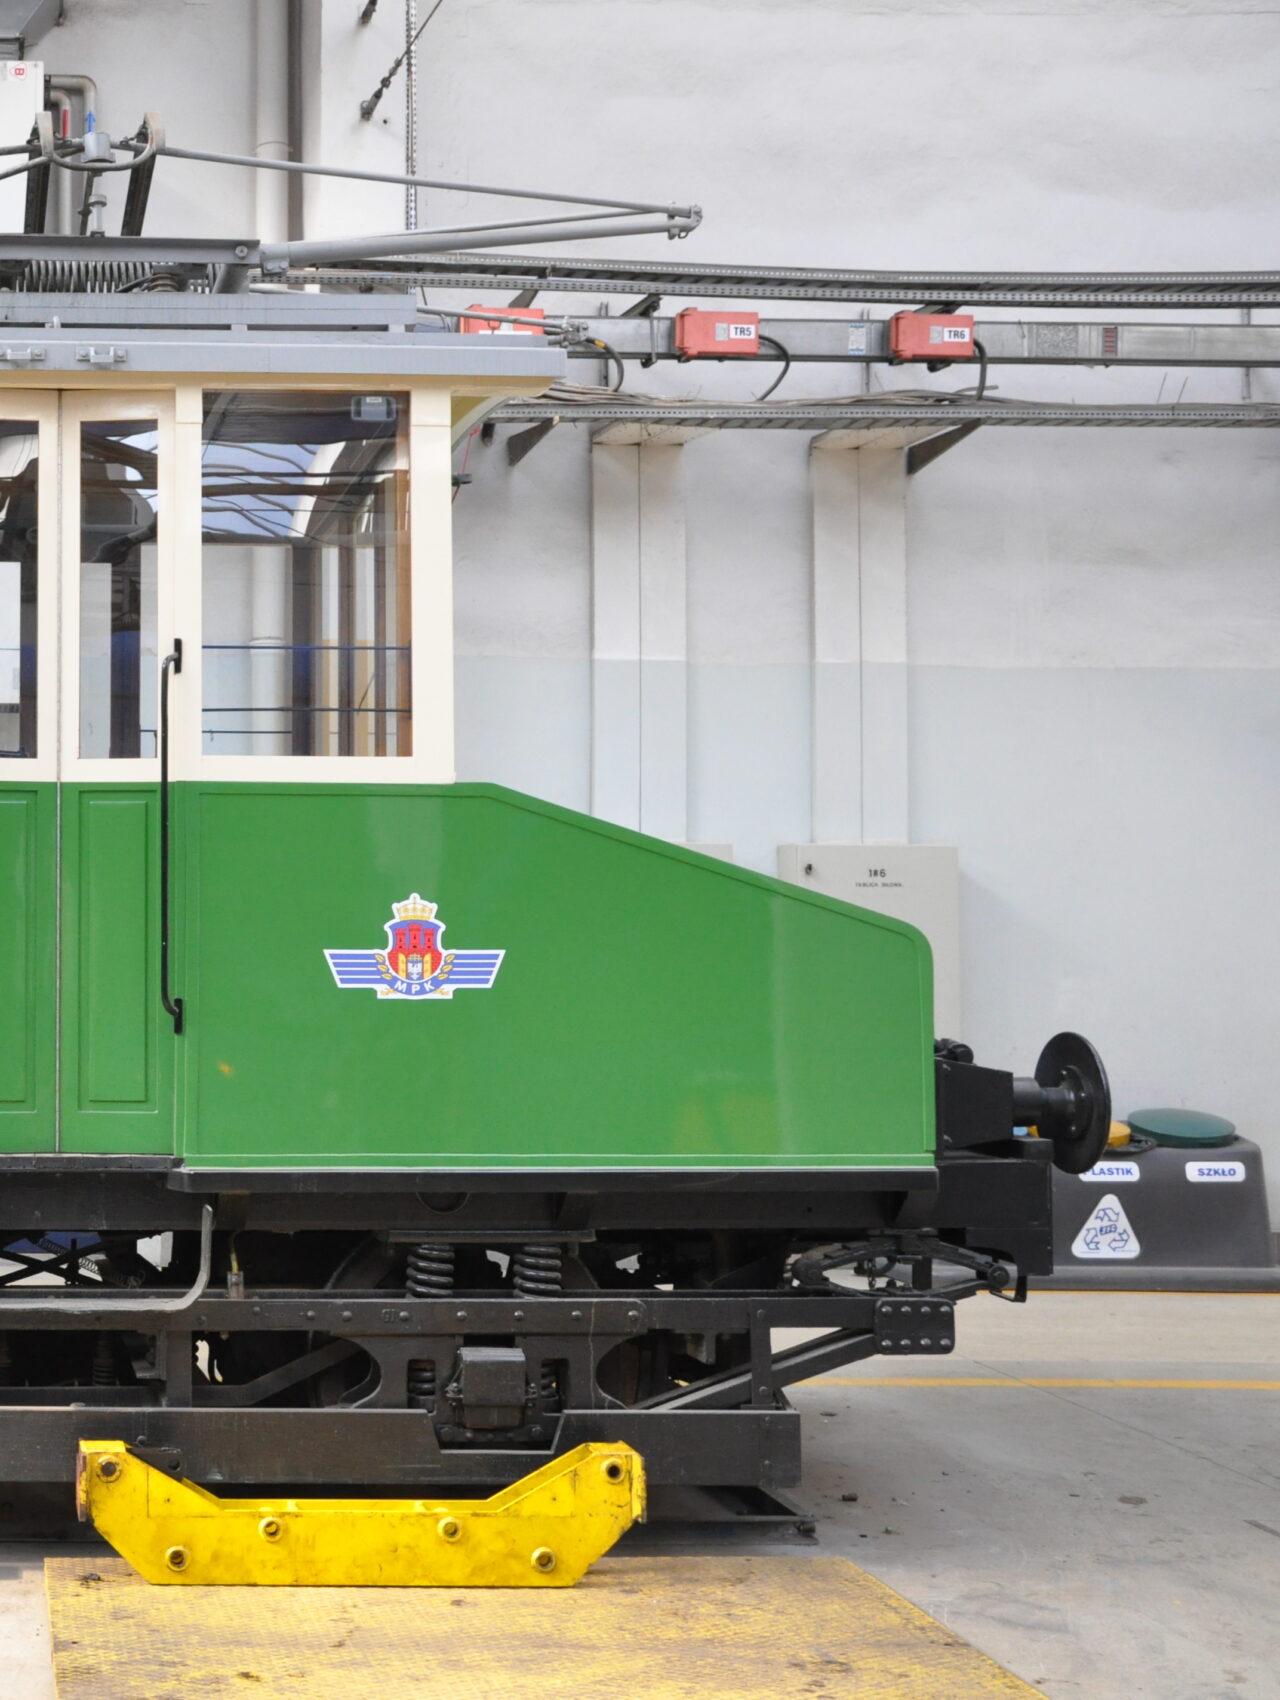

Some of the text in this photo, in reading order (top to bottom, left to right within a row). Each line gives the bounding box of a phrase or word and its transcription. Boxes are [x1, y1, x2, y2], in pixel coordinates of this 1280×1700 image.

[733, 326, 752, 337] TR5
[948, 328, 966, 340] TR6
[394, 980, 435, 994] MPK
[1083, 1167, 1133, 1176] LASTIK
[1197, 1167, 1237, 1177] SZKŁO
